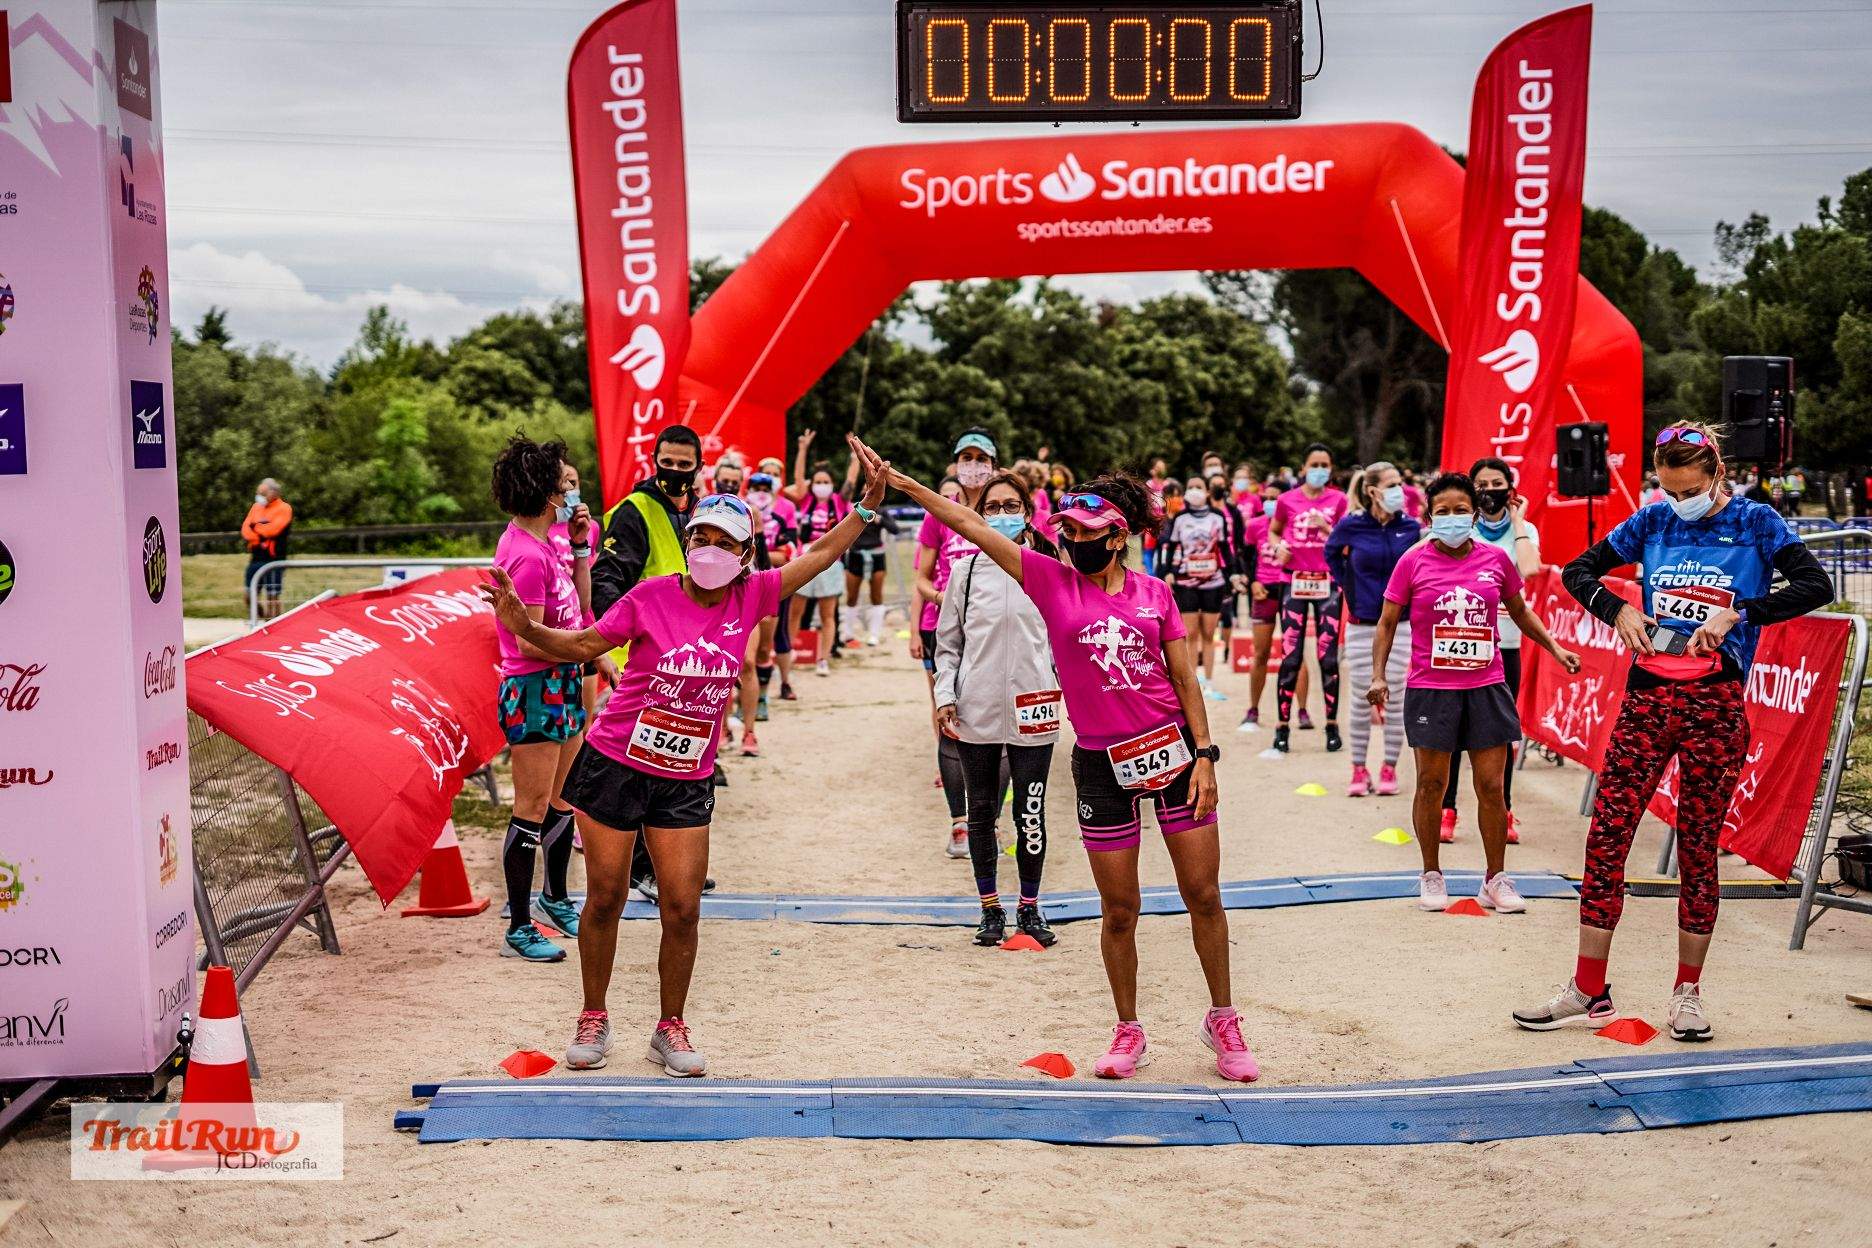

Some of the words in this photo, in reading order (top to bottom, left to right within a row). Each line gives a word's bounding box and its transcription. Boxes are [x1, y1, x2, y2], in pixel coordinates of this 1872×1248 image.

[926, 17, 1272, 103] 00:00:00
[602, 45, 660, 316] Santander
[899, 167, 1034, 218] Sports
[1101, 154, 1334, 200] Santander
[1496, 60, 1553, 322] Santander
[4, 191, 17, 200] de
[1016, 214, 1213, 242] sportssantander.es
[148, 548, 166, 594] Life
[1468, 608, 1489, 625] Trail
[1669, 599, 1709, 622] 465
[1448, 641, 1477, 655] 431
[649, 674, 686, 699] Trail
[1031, 704, 1054, 720] 496
[653, 731, 692, 755] 548
[1134, 749, 1170, 776] 549
[1021, 781, 1044, 855] adidas
[26, 1036, 64, 1046] diferencia
